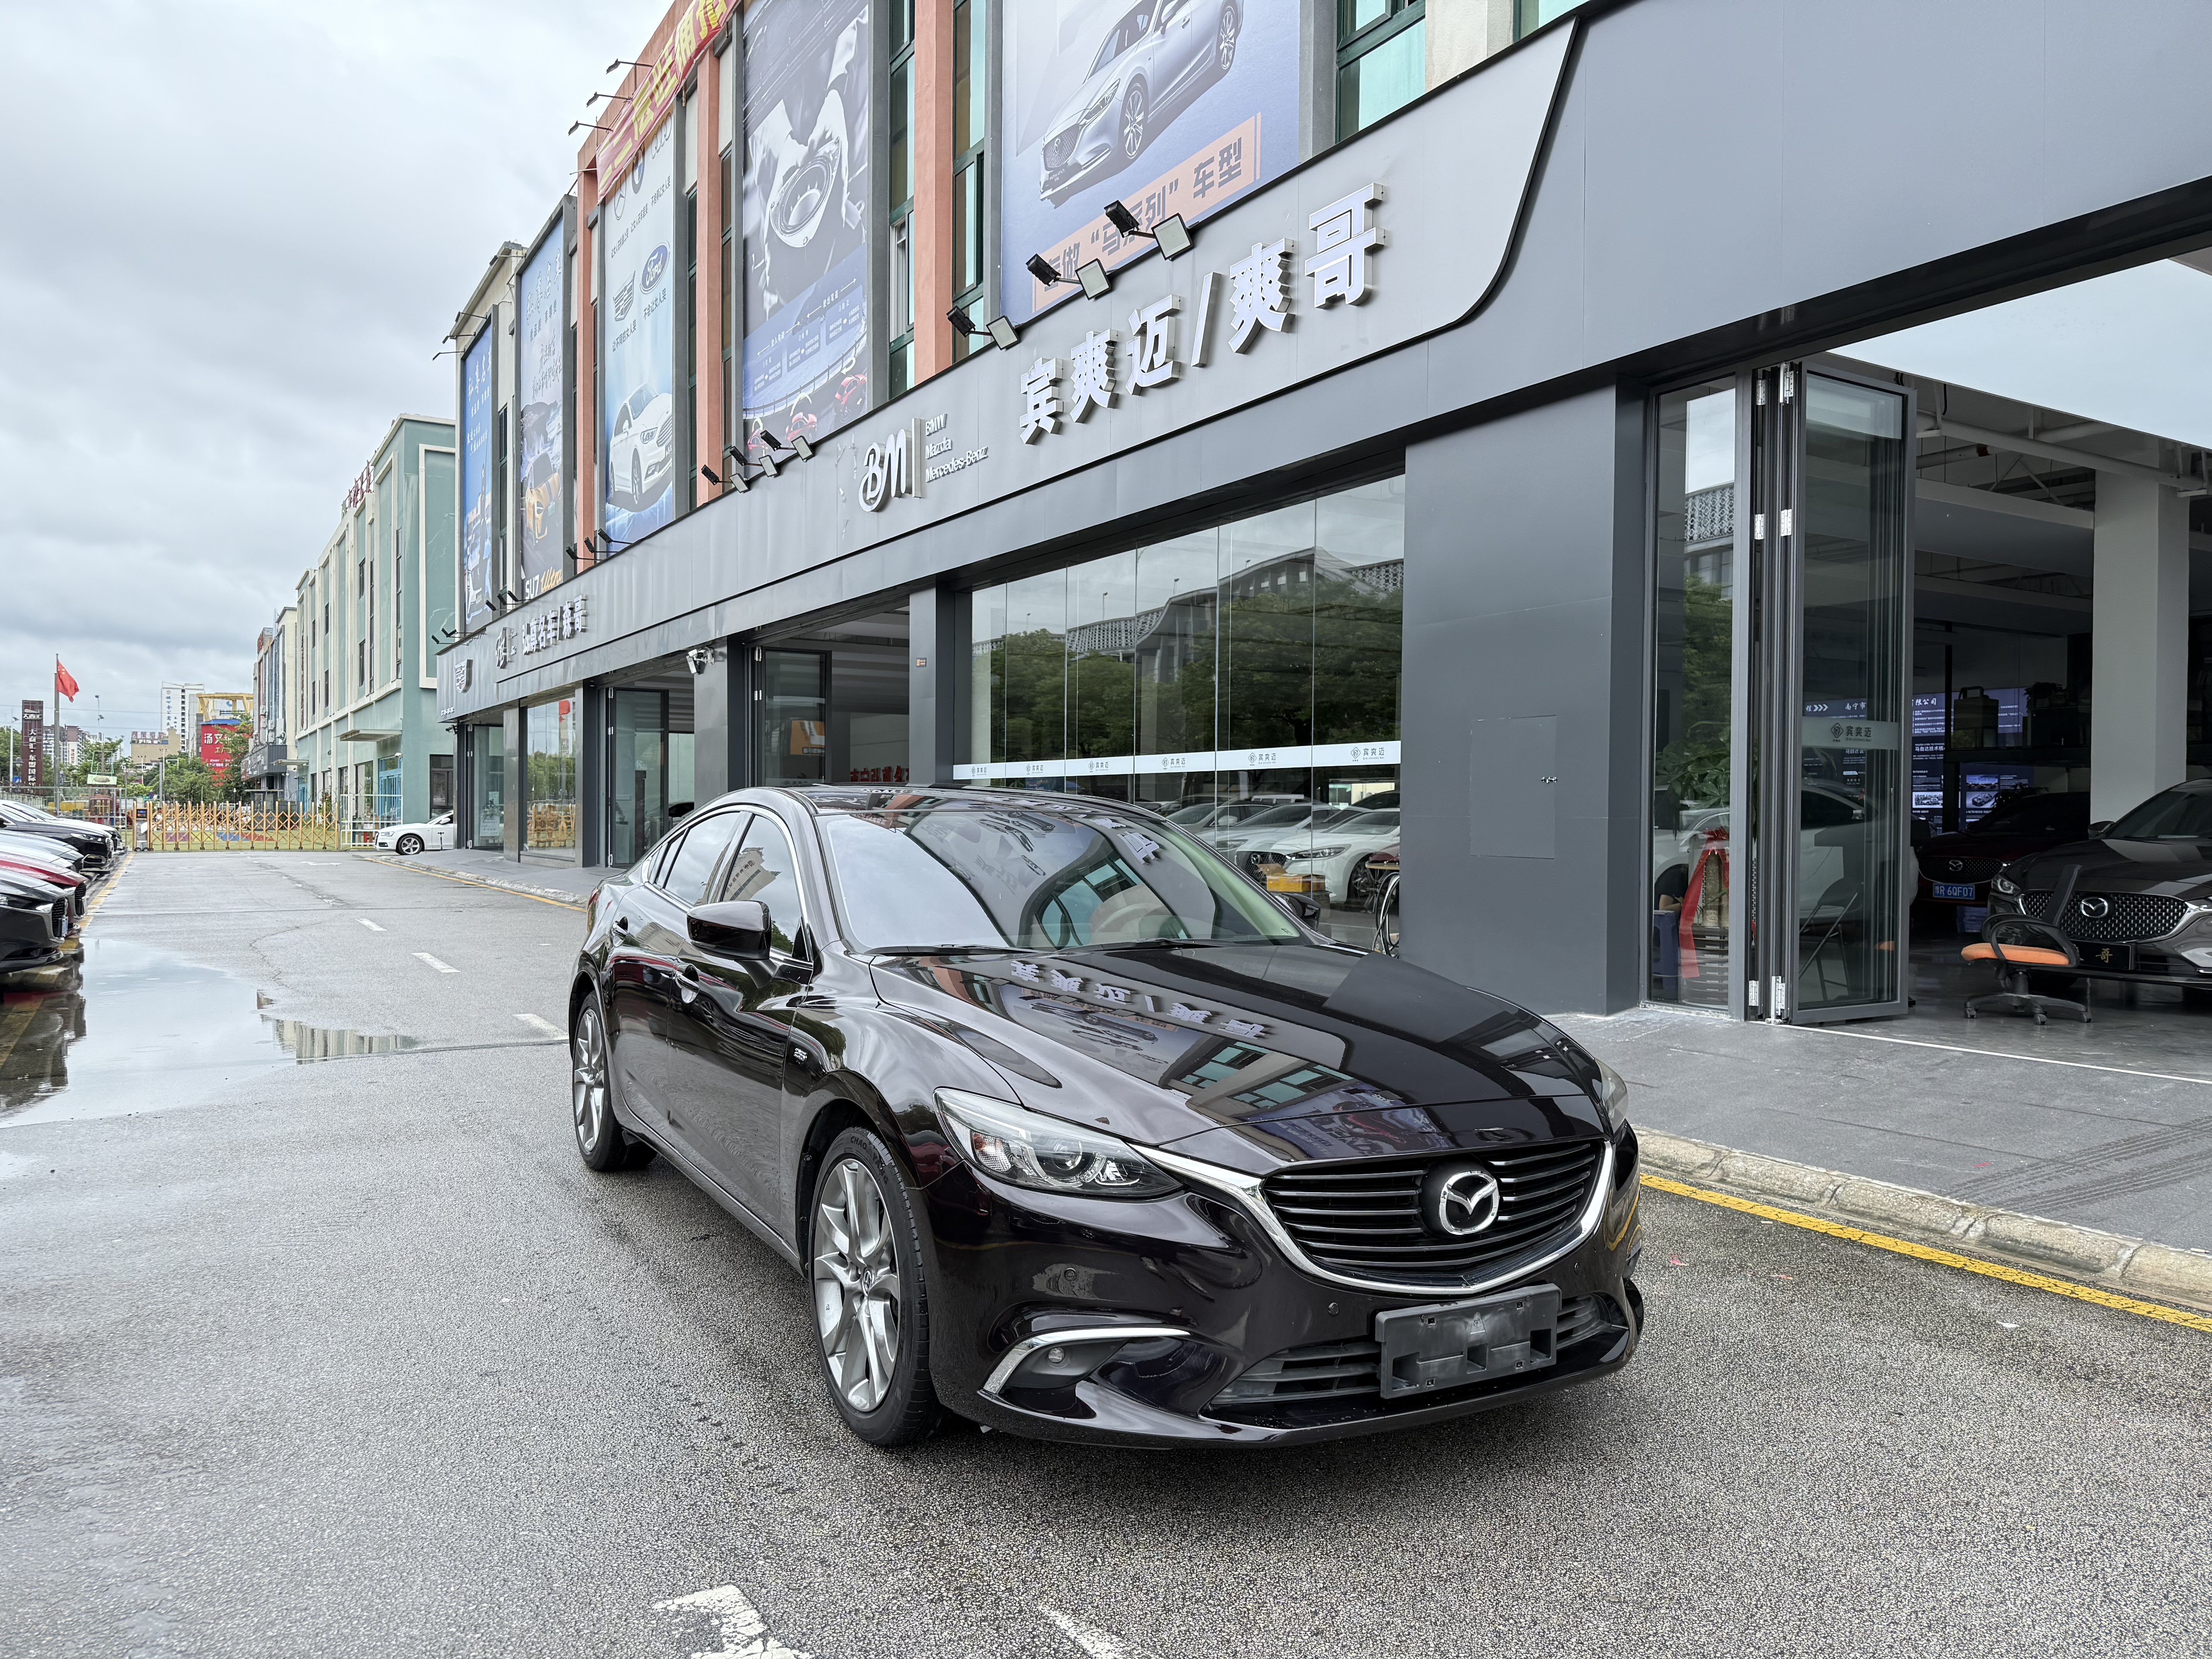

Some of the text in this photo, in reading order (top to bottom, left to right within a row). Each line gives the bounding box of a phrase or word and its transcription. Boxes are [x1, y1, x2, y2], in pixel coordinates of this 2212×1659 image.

[646, 251, 663, 286] Ford
[925, 413, 948, 436] BMW
[925, 436, 953, 460] Mazda
[925, 446, 988, 483] Mercedes-Benz
[526, 566, 562, 600] SU7 Ultra
[1846, 726, 1872, 737] 宾爽迈
[1364, 748, 1384, 756] 宾爽迈
